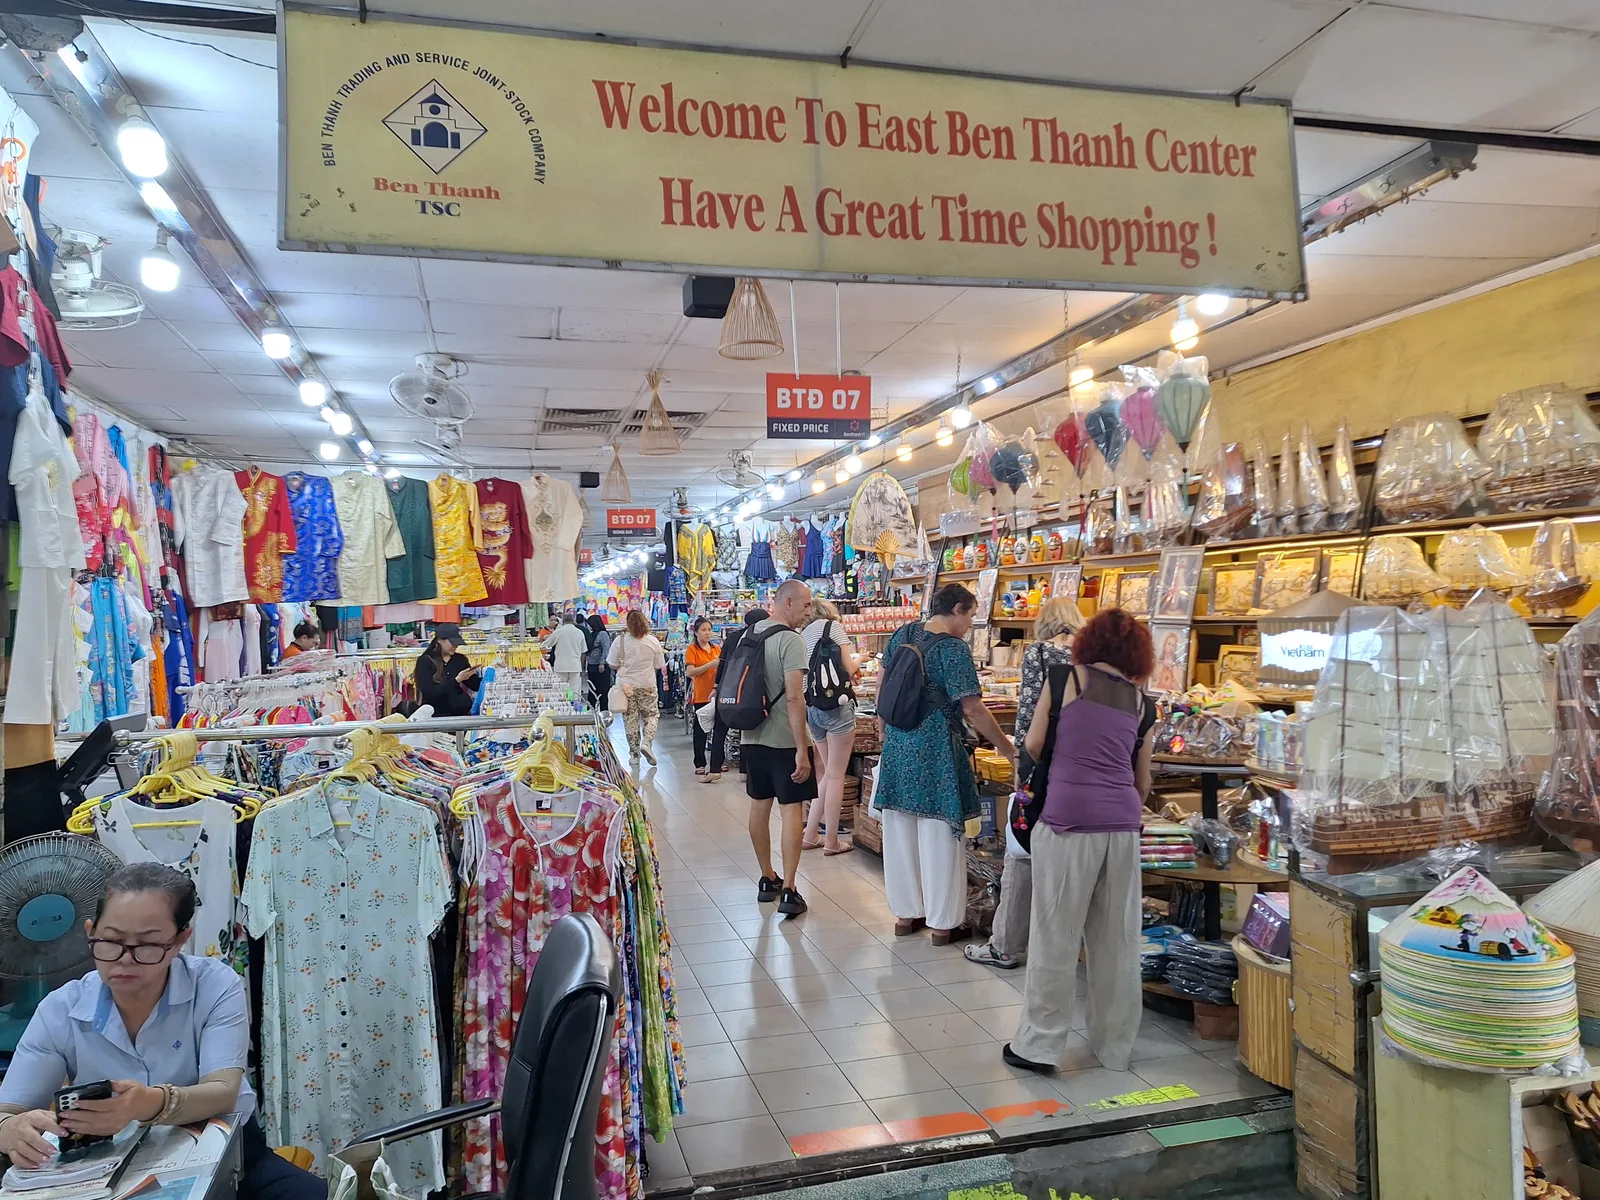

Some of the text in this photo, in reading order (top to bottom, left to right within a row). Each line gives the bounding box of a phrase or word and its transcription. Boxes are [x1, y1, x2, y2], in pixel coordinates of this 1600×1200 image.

[321, 52, 546, 184] BEN THANH TRADING AND SERVICE JOINT-STOCK COMPANY
[591, 80, 1257, 177] Welcome To East Ben Thanh Center
[372, 176, 501, 200] Ben Thanh
[415, 199, 460, 217] TSC
[661, 178, 765, 232] Have
[776, 185, 806, 234] A
[816, 189, 925, 241] Great
[931, 195, 1026, 247] Time
[776, 387, 861, 410] BTĐ 07
[772, 423, 829, 433] FIXED PRICE
[636, 515, 651, 524] 07
[1281, 646, 1324, 657] Vietnam
